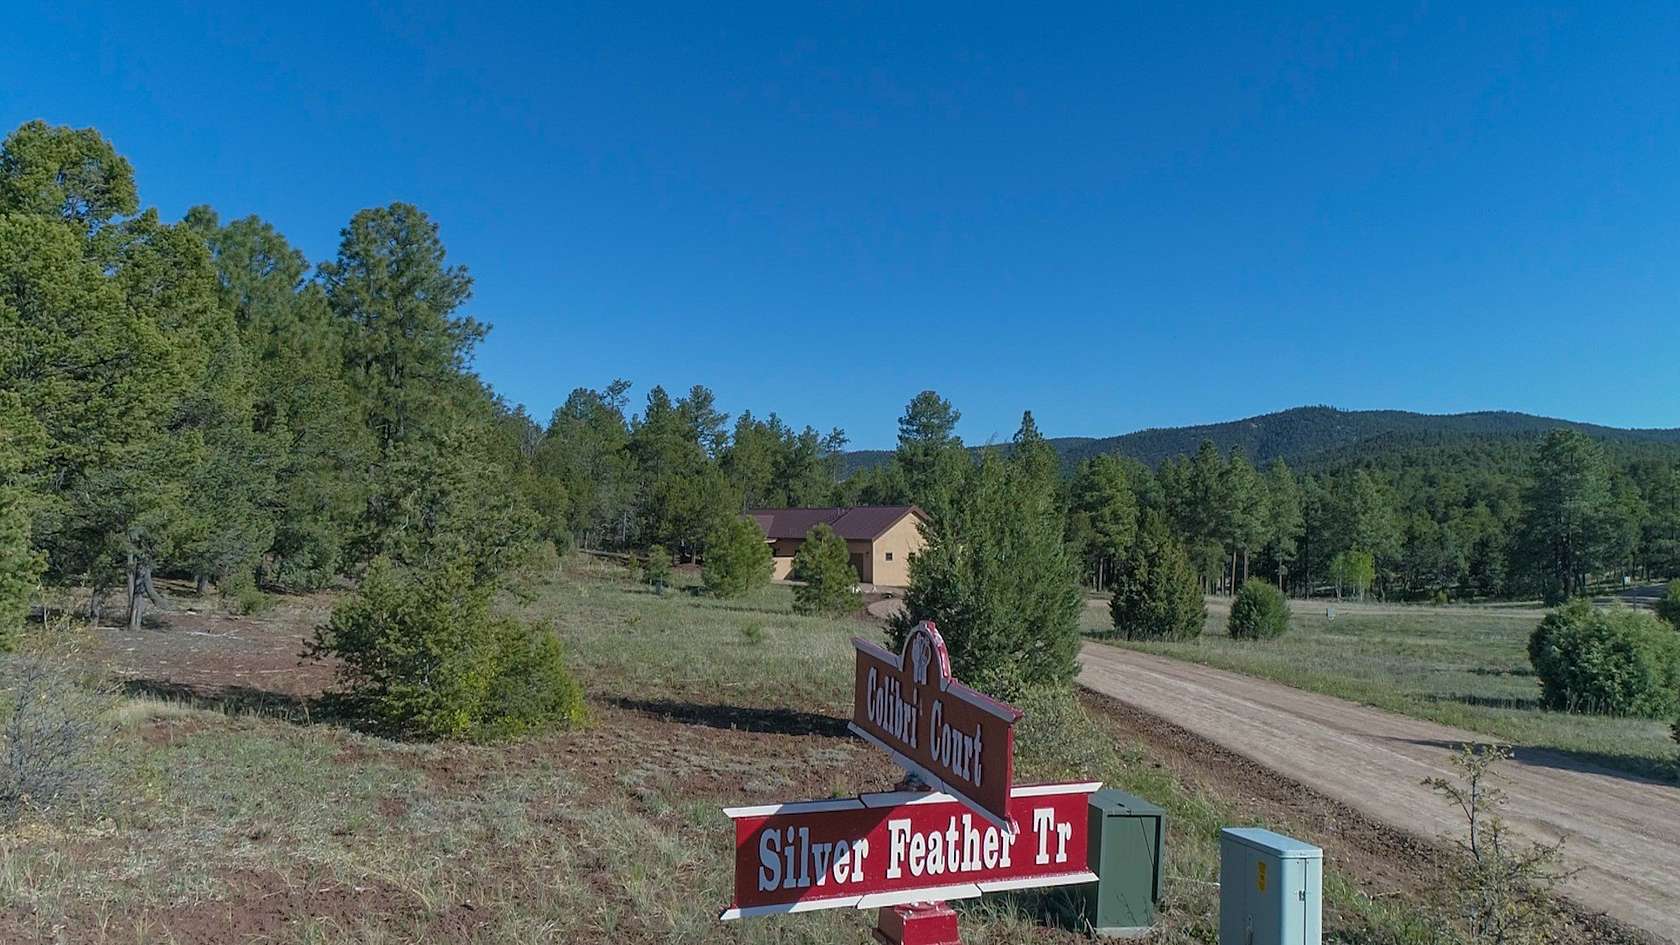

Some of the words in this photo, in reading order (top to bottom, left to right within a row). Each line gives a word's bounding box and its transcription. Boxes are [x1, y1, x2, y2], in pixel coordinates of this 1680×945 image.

[867, 666, 918, 749] Colibri
[930, 700, 983, 788] Court
[758, 826, 869, 892] Silver
[887, 814, 1016, 879] Feather
[1033, 808, 1072, 865] Tr
